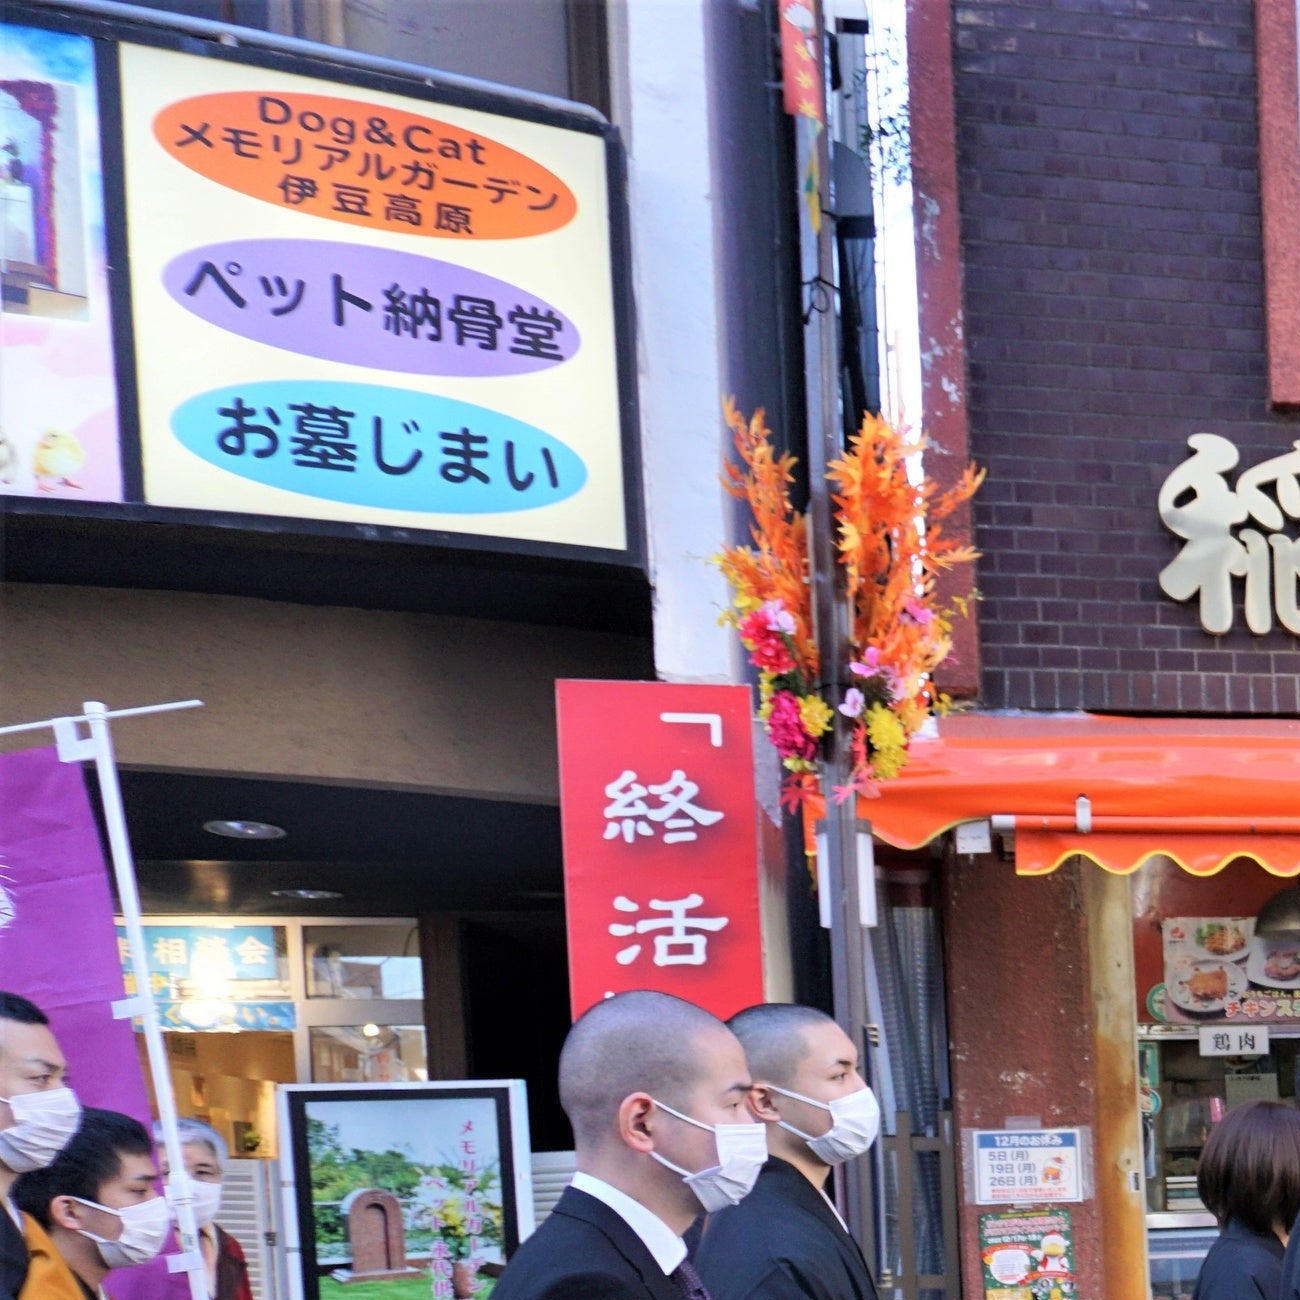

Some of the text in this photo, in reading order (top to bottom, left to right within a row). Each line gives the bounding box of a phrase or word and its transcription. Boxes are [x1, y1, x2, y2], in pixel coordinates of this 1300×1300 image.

[257, 95, 487, 166] Dog&Cat
[175, 120, 560, 213] メモリアルガーデン
[277, 173, 475, 236] 伊豆高原
[184, 258, 566, 362] ペット納骨堂
[215, 397, 562, 492] お墓じまい
[1212, 1032, 1257, 1051] 鶏肉
[994, 1134, 1063, 1147] 12月のお休み
